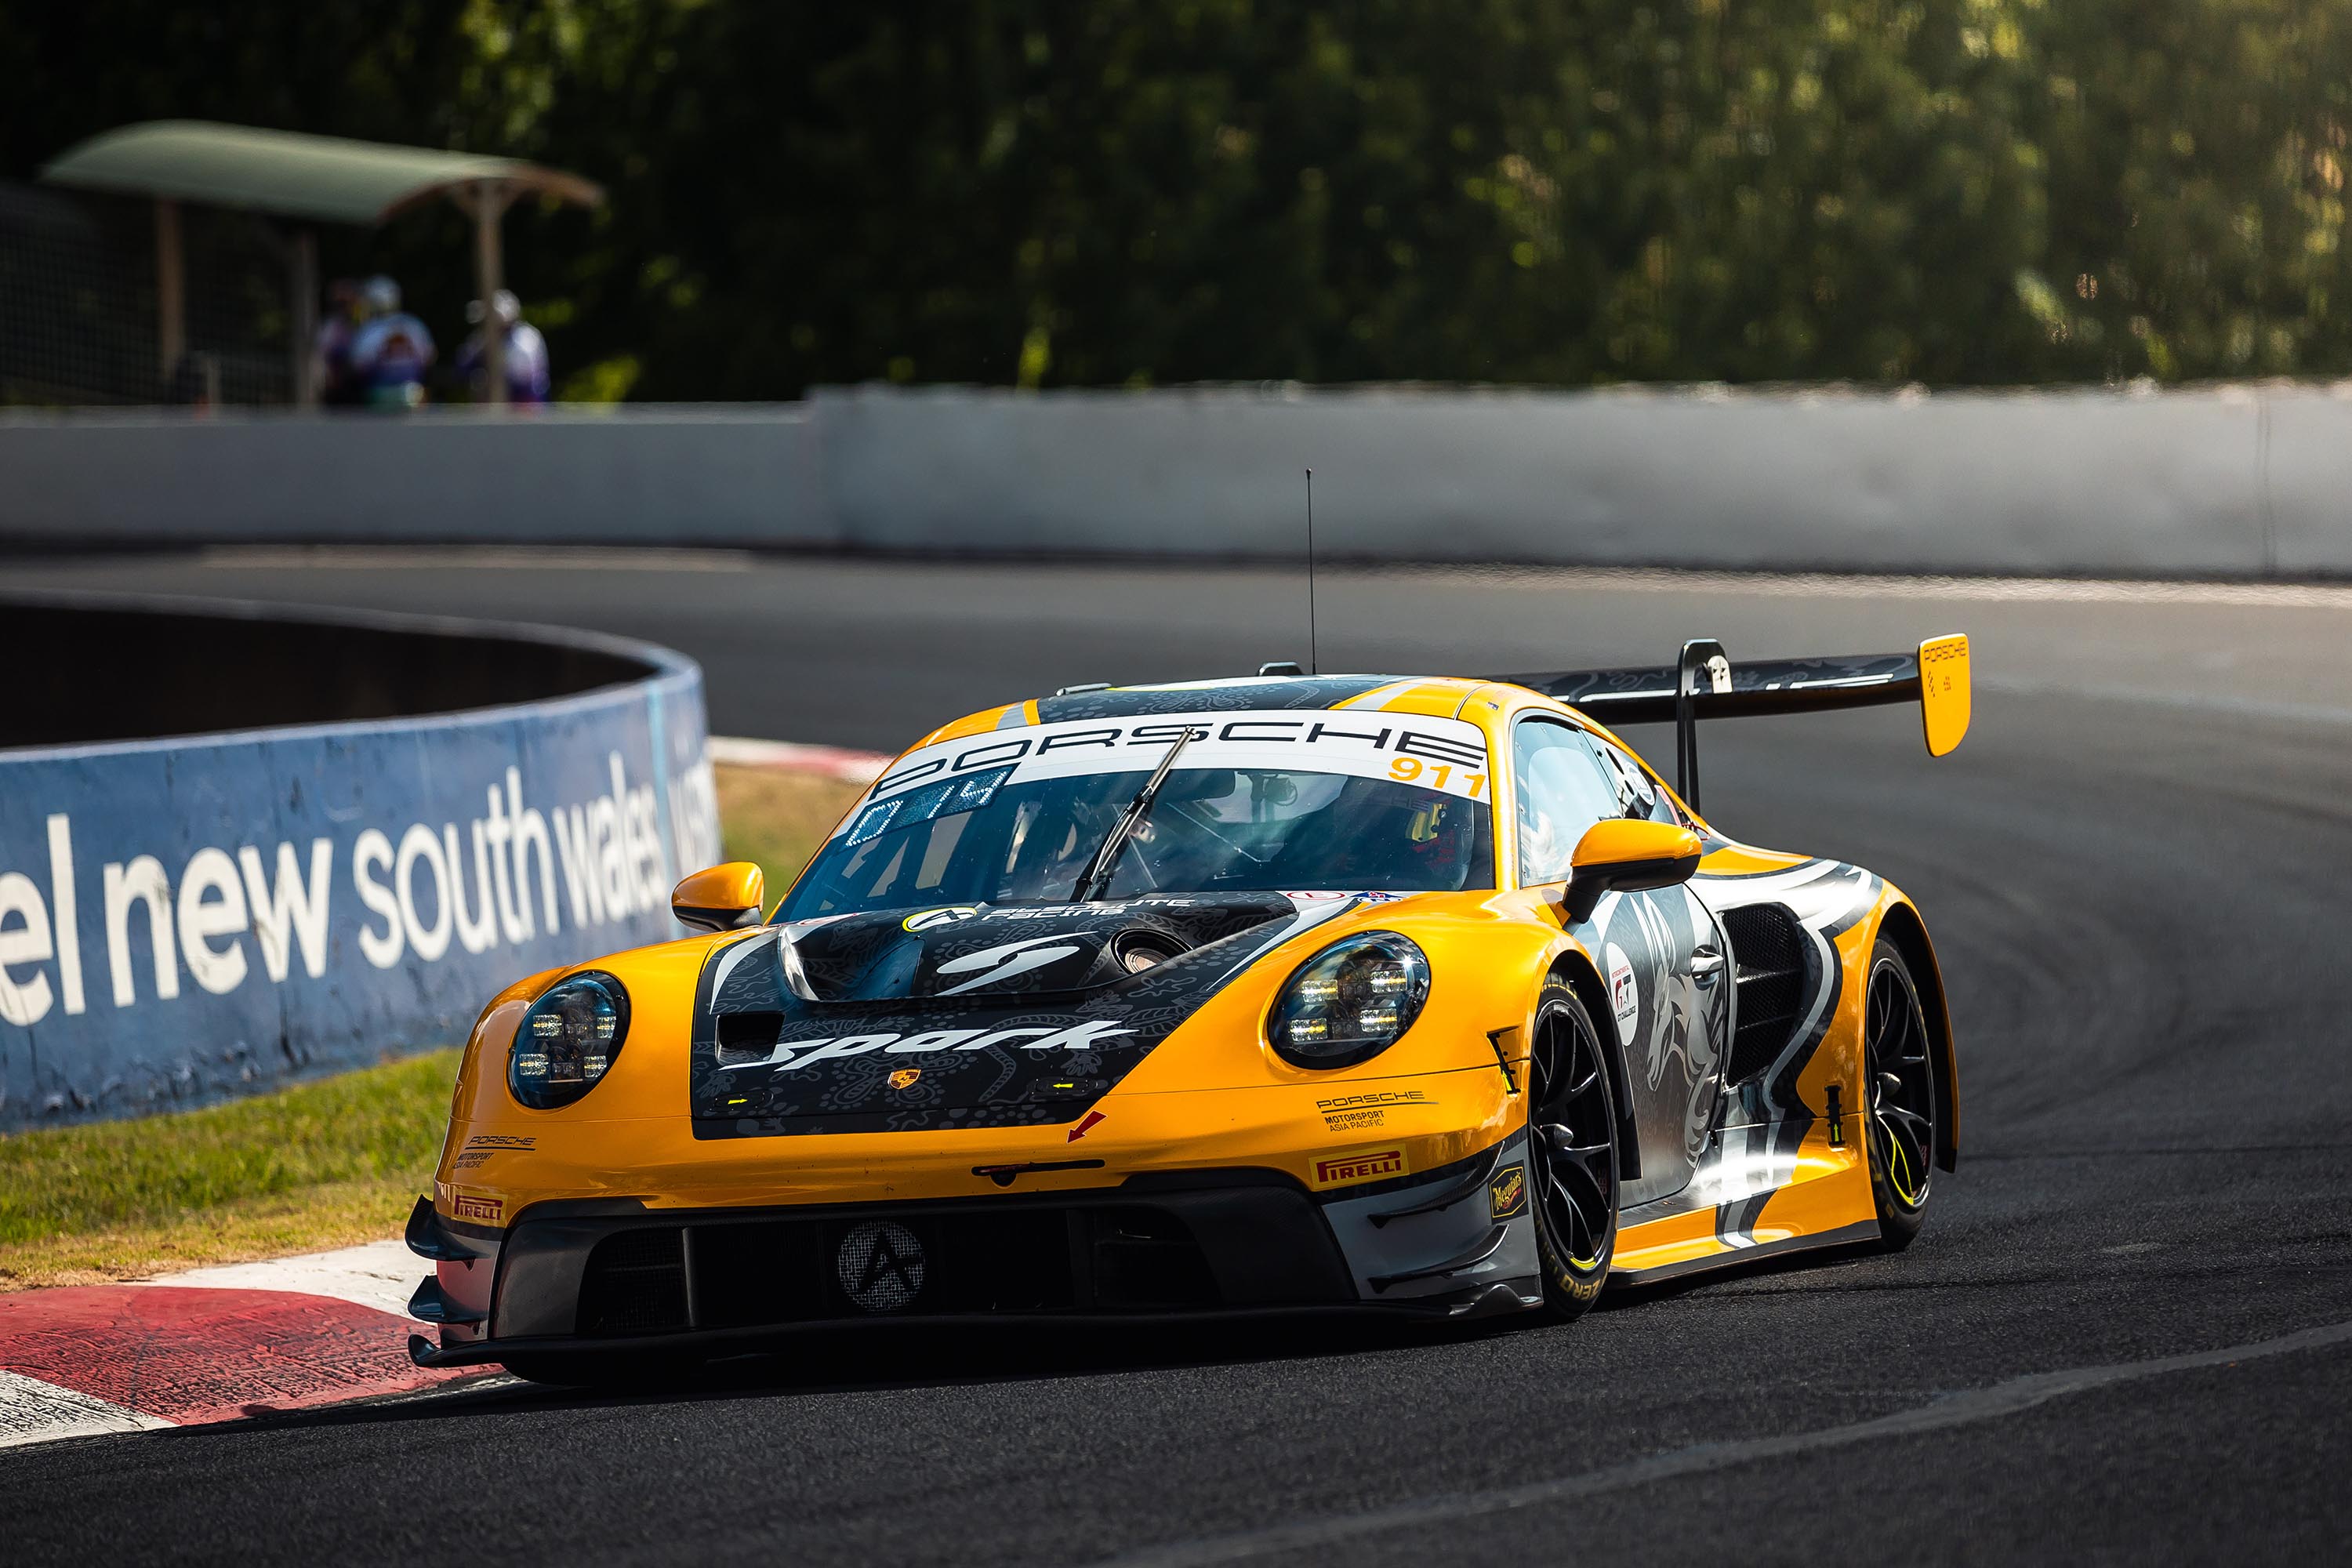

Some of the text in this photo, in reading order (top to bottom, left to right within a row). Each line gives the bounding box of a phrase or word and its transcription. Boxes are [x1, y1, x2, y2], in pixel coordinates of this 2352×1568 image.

[867, 721, 1486, 802] PORSCHE
[1388, 757, 1487, 799] 911
[103, 837, 334, 1008] new
[353, 765, 560, 971] south
[551, 749, 668, 931] wales
[717, 1020, 1140, 1072] spark
[1316, 1091, 1425, 1109] PORSCHE
[1324, 1110, 1385, 1124] MOTORSPORT
[1329, 1118, 1385, 1132] ASIA PACIFIC
[469, 1136, 536, 1145] PORSCHE
[1316, 1149, 1402, 1182] PIRELLI
[454, 1194, 503, 1221] PIRELLI
